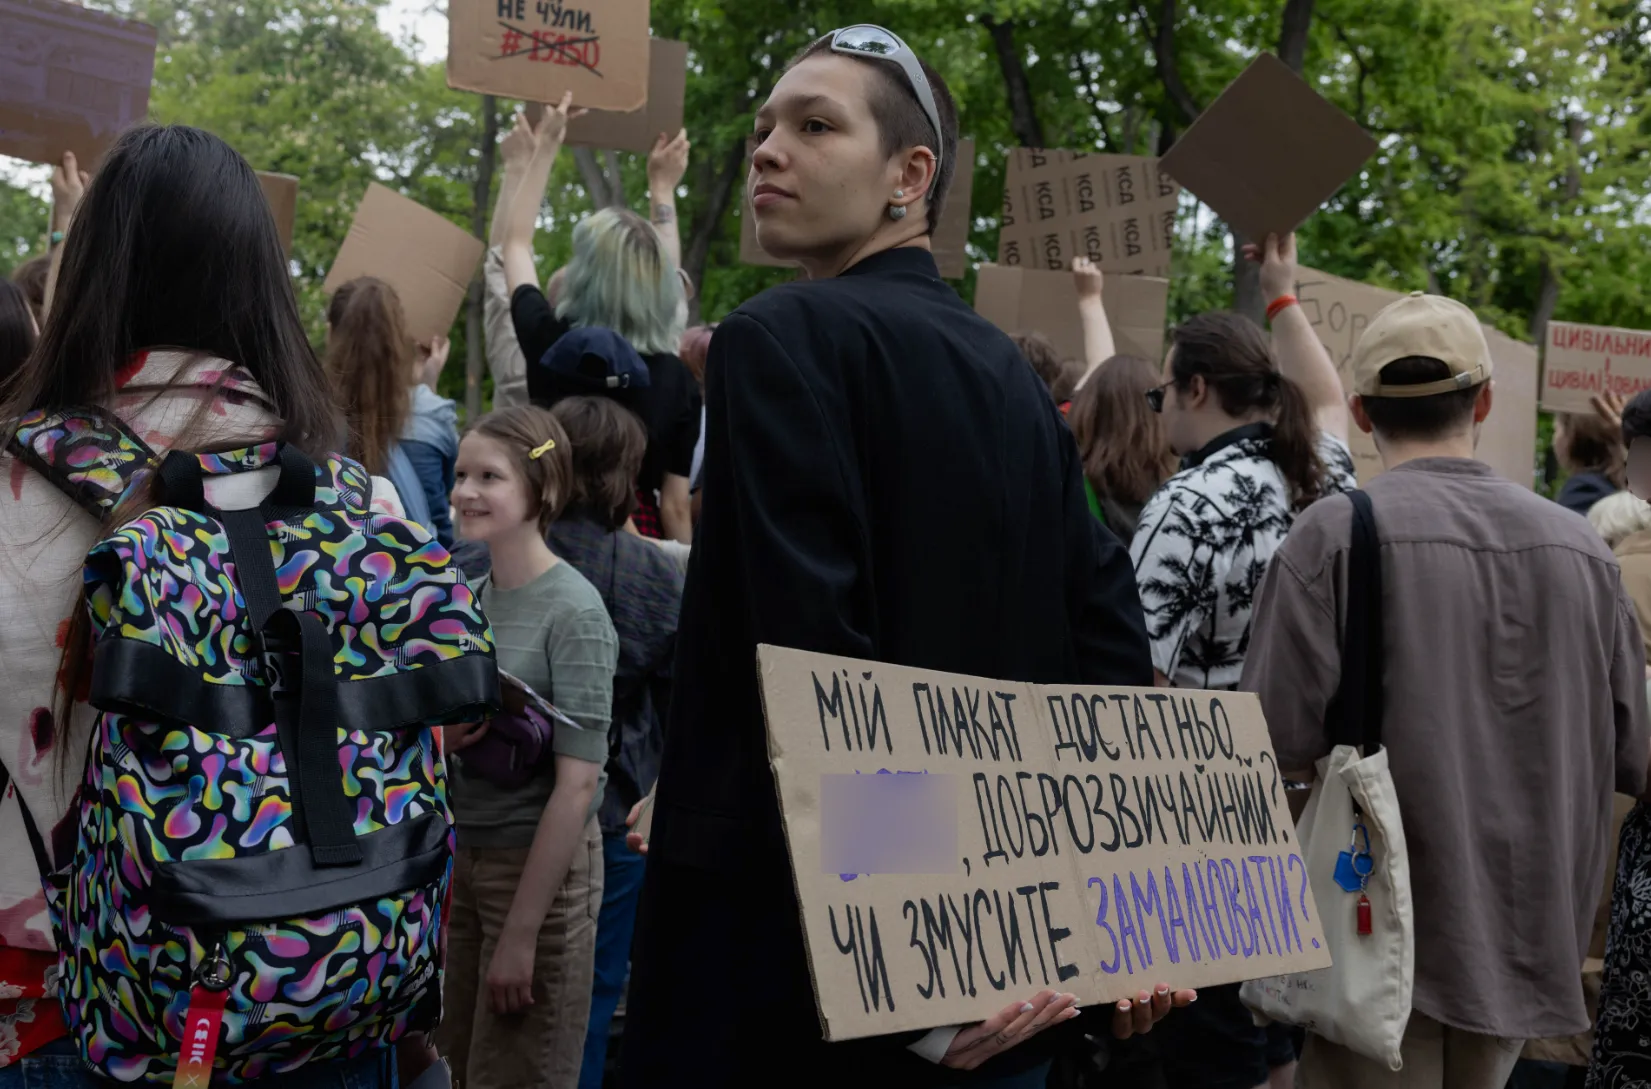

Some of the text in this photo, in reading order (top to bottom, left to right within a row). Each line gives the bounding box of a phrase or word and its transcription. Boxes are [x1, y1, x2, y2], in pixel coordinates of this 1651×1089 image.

[496, 0, 525, 21] НЕ
[811, 668, 893, 756] МІЙ
[912, 682, 1023, 763] ПЛАКАТ
[828, 852, 1321, 1015] ЧИ ЗМУСИТЕ ЗАМАЛЮВАТИ?
